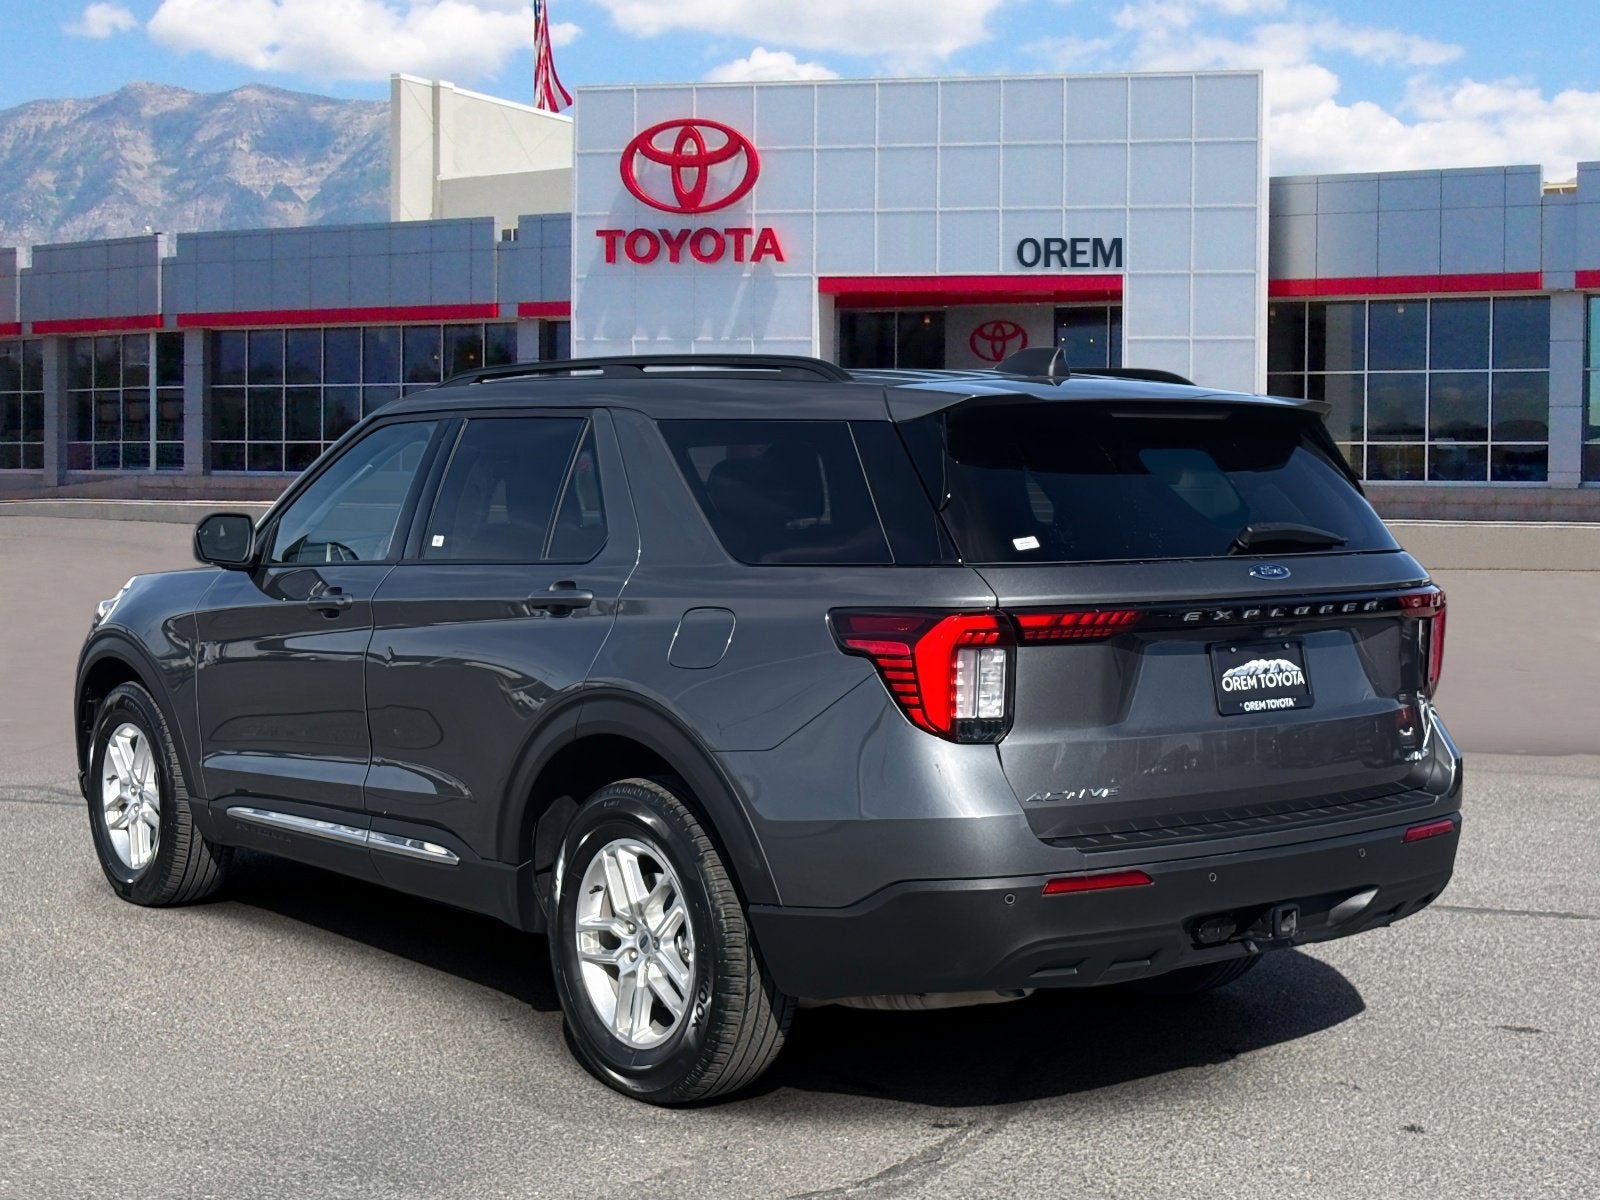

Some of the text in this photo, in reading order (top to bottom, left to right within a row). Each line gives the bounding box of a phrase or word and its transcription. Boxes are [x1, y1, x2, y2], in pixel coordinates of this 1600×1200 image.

[596, 227, 784, 264] TOYOTA
[1017, 237, 1122, 268] OREM
[1183, 601, 1380, 622] EXPLORER
[1222, 671, 1305, 692] OREM TOYOTA
[1244, 697, 1294, 712] OREM TOYOTA
[1025, 786, 1121, 802] ACTIVE
